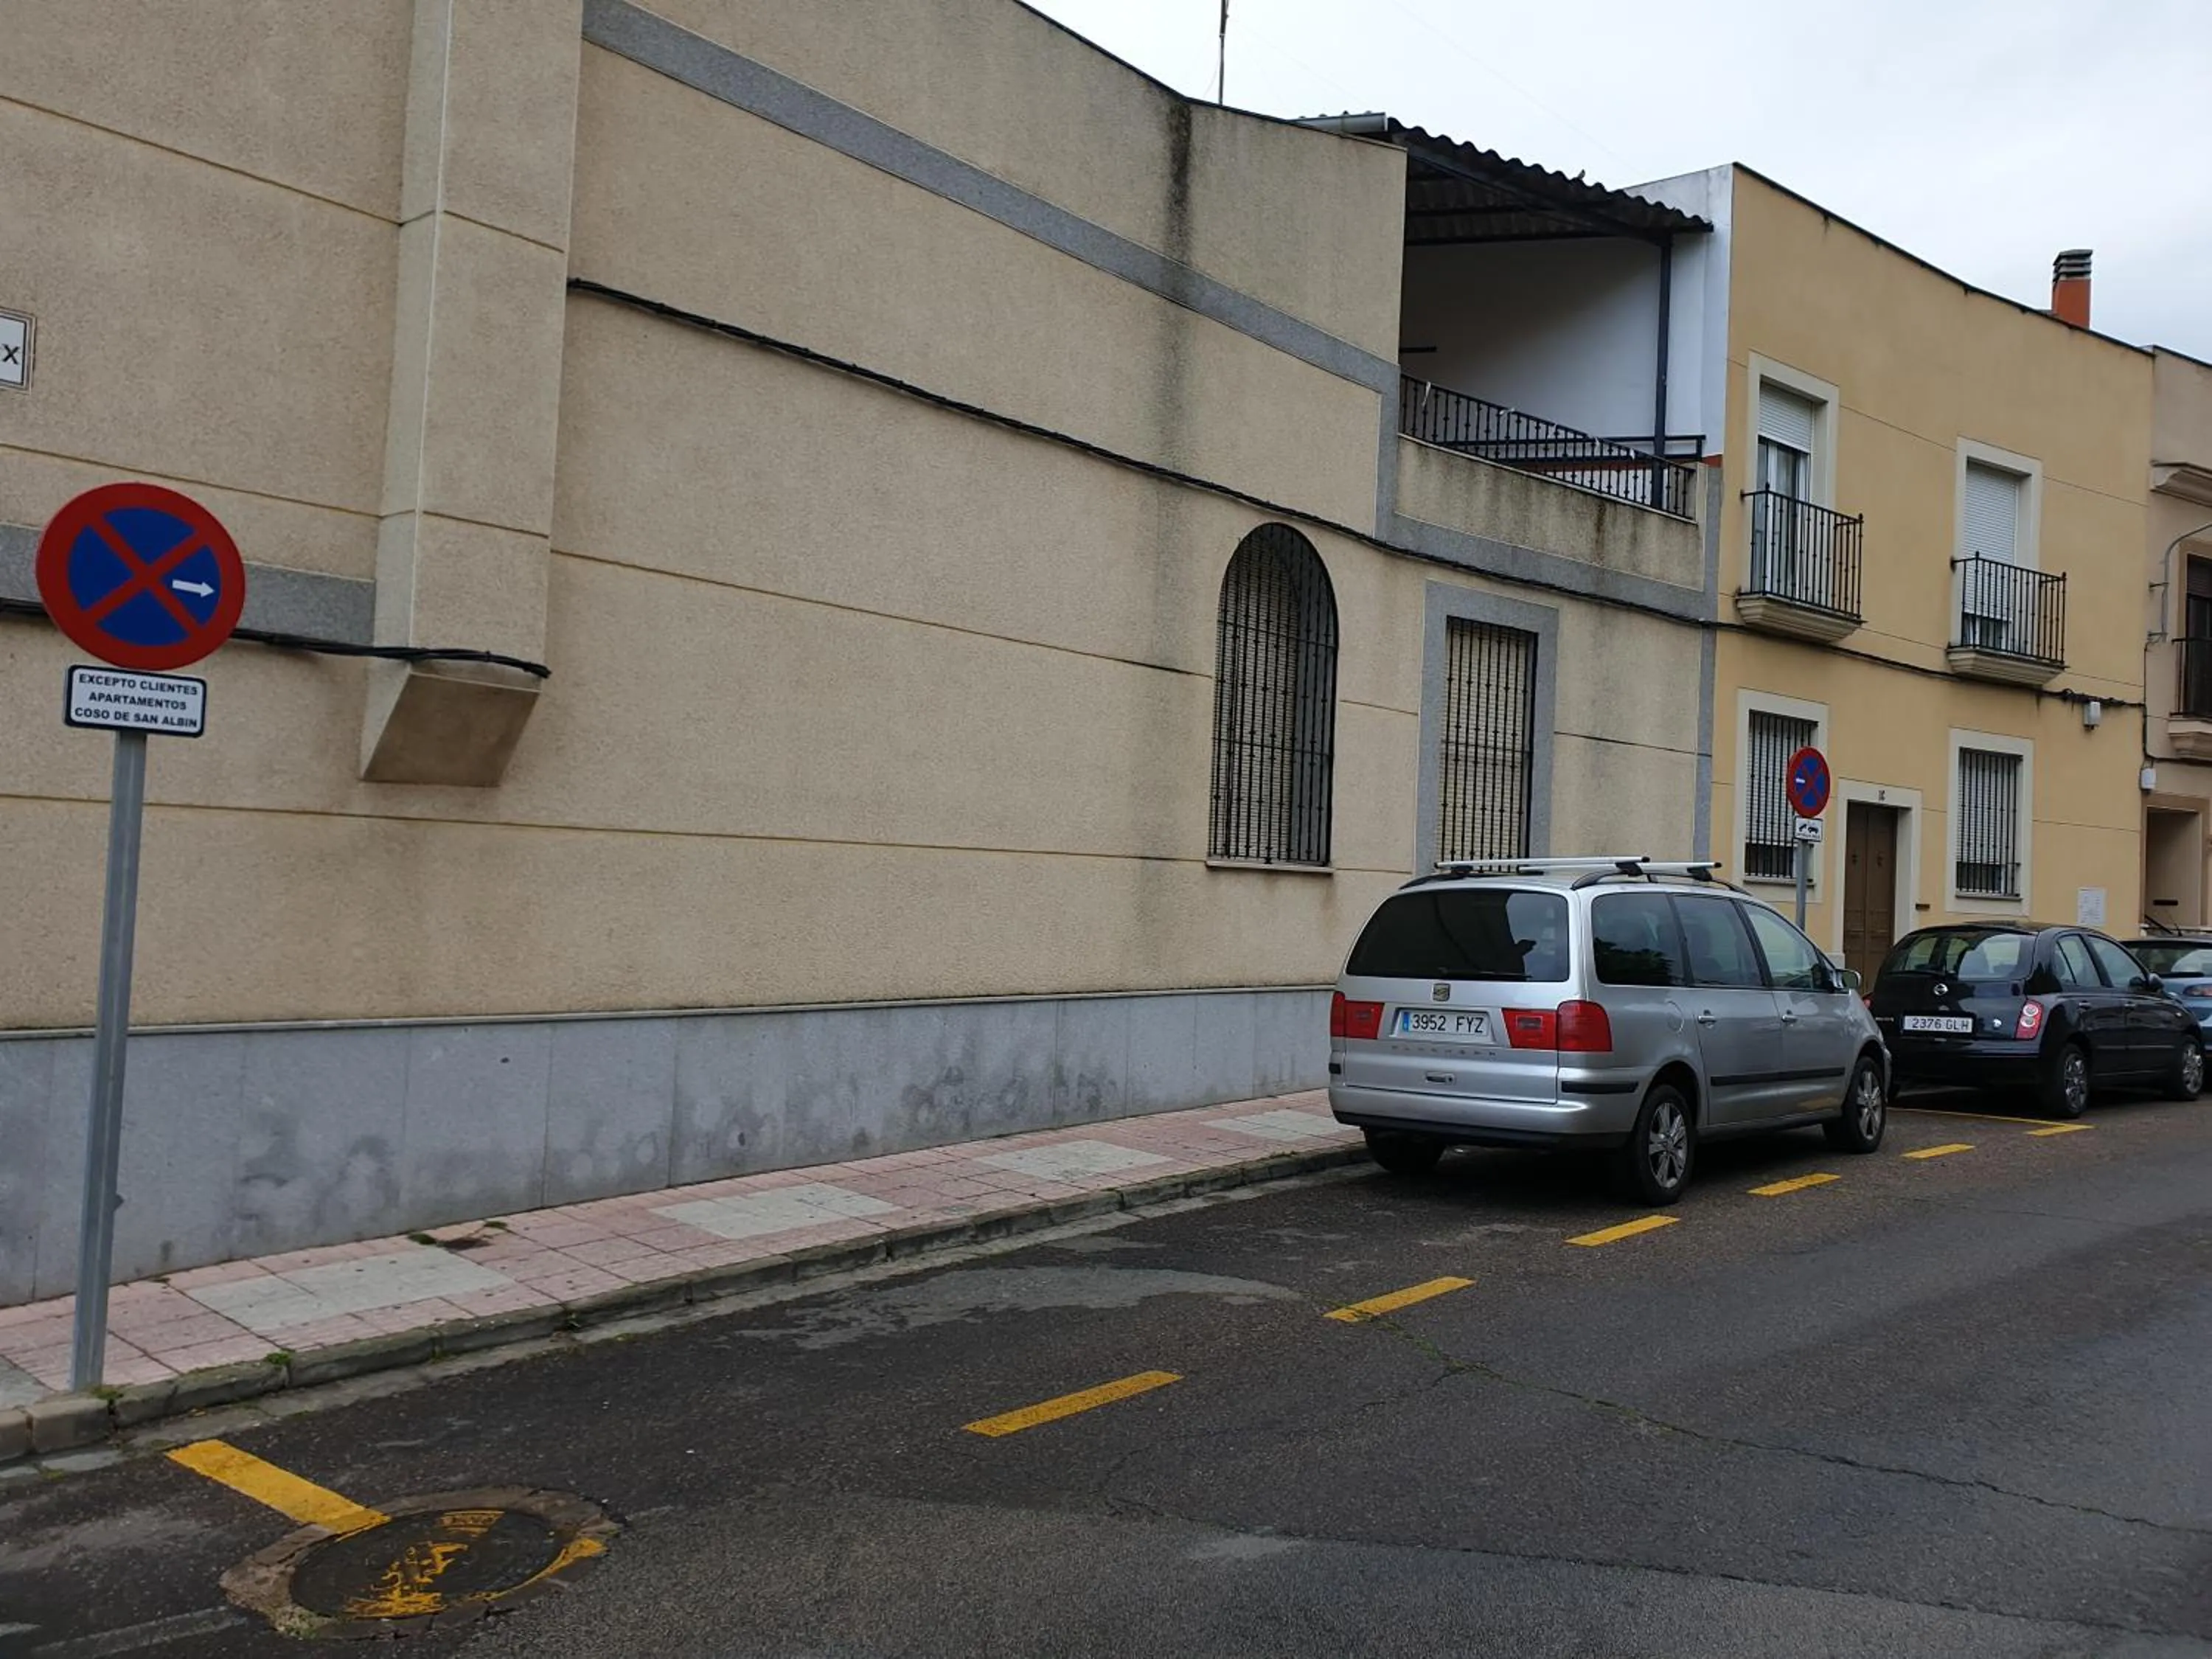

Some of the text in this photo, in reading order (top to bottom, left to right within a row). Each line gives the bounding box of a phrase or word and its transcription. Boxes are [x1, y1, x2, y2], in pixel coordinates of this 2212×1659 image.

[79, 673, 198, 695] EXCEPTO CLIENTES
[88, 692, 187, 710] APARTAMENTOS
[74, 707, 197, 728] COSO DE SAN ALBIN
[1412, 1014, 1484, 1034] 3952 FYZ
[1912, 1018, 1969, 1031] 2376 GLH
